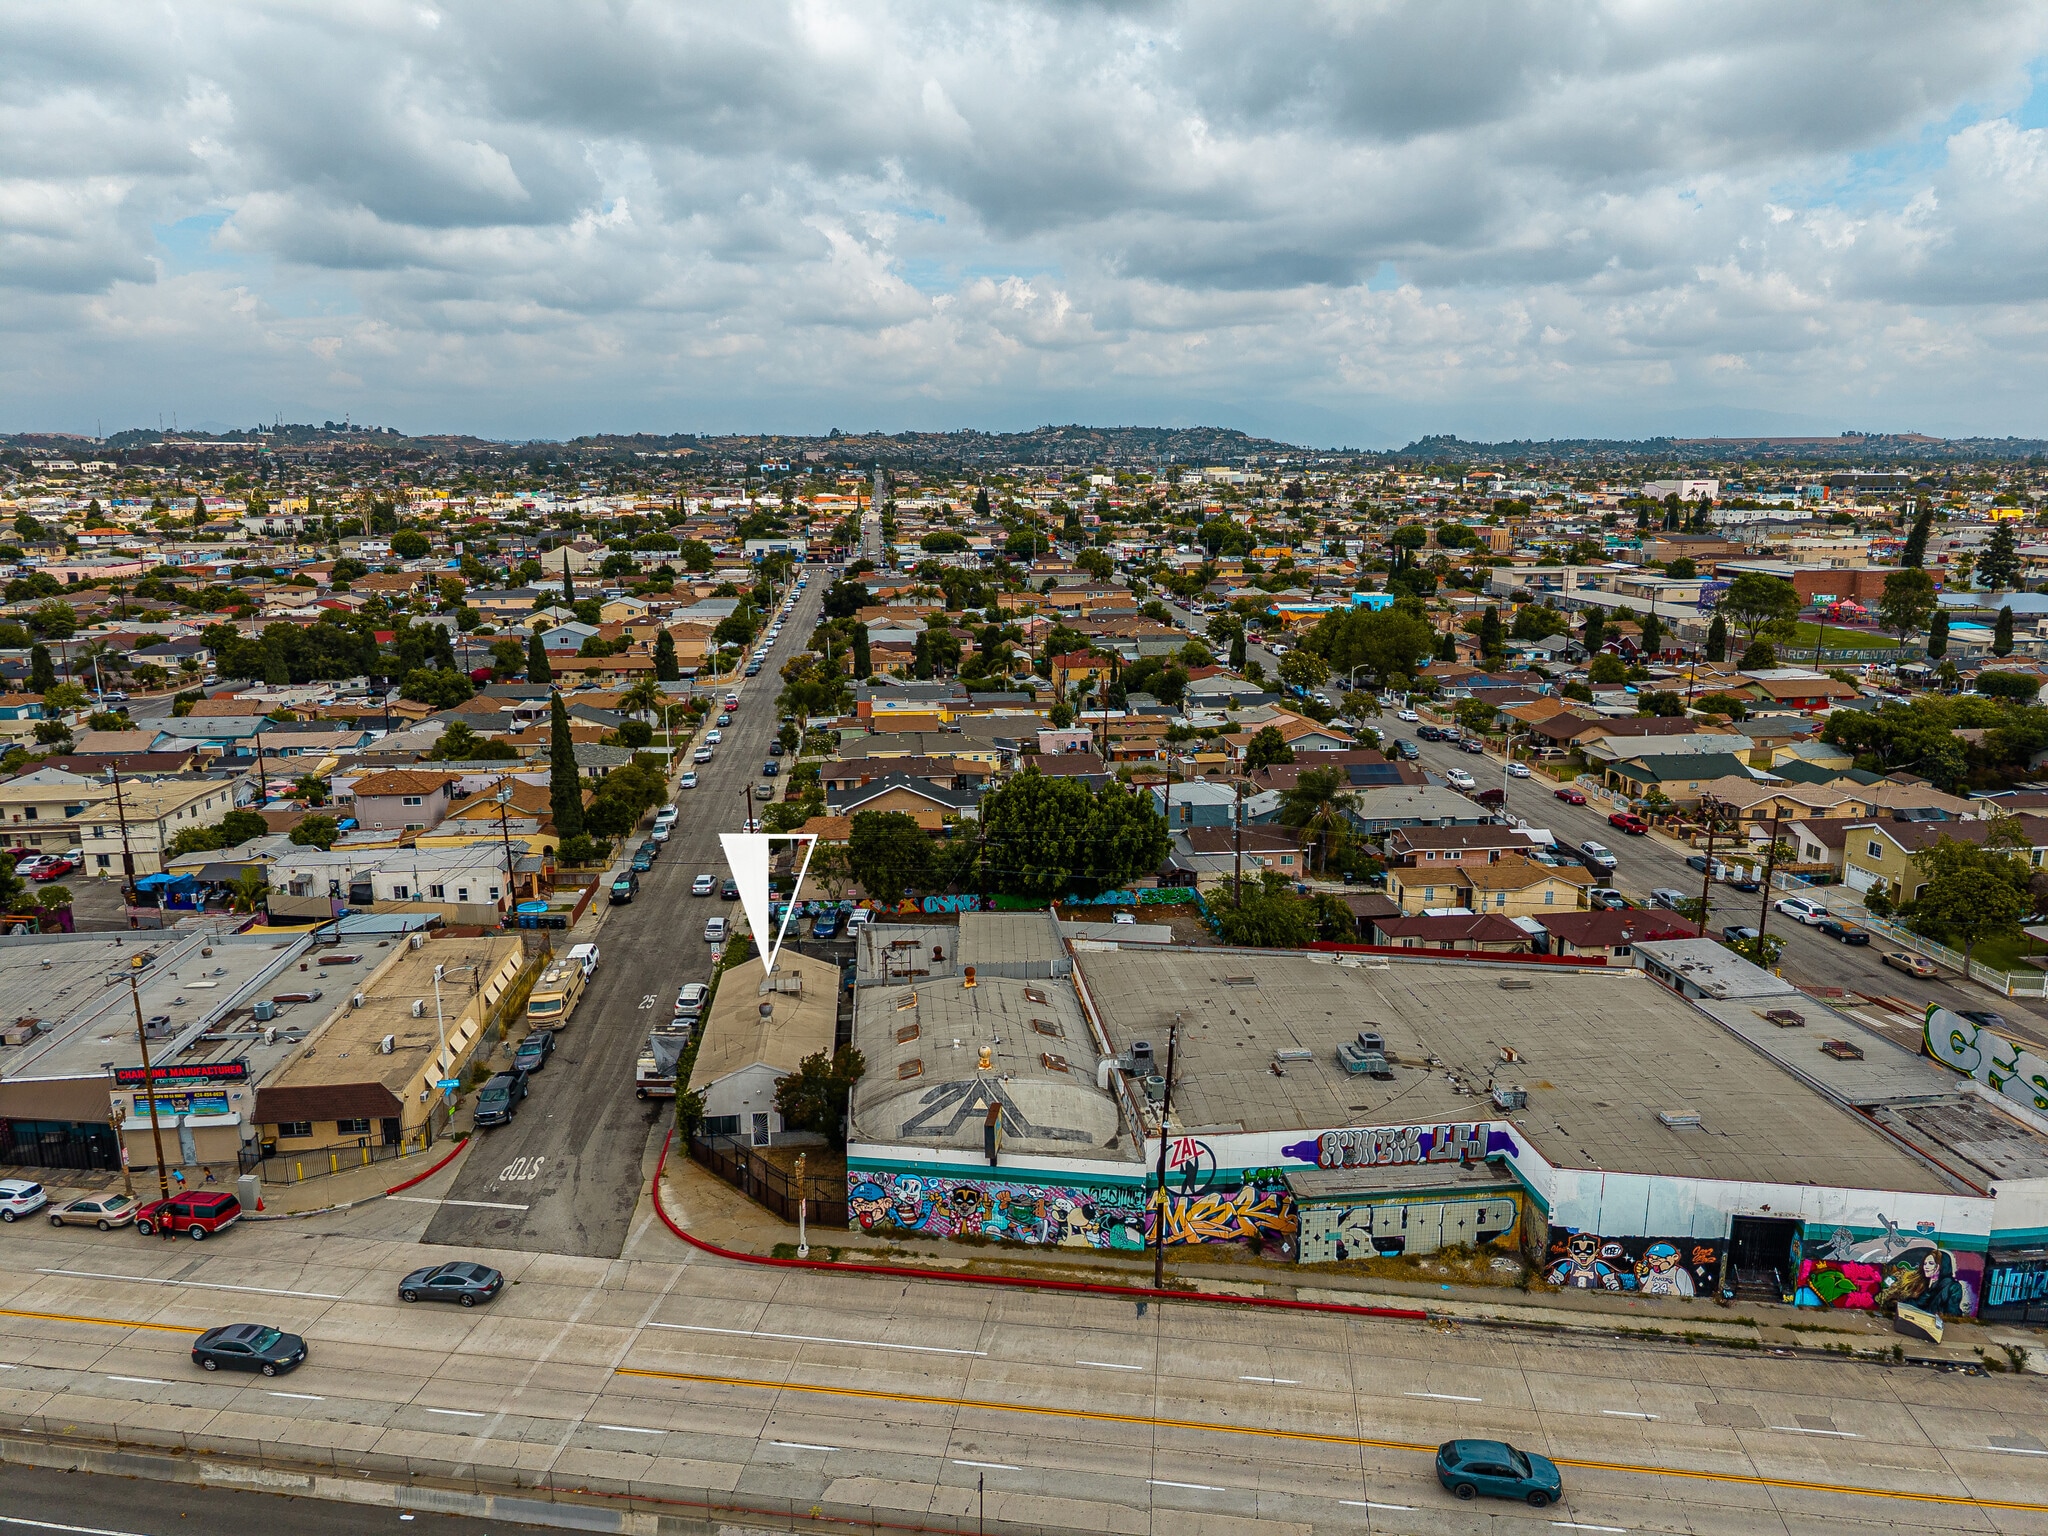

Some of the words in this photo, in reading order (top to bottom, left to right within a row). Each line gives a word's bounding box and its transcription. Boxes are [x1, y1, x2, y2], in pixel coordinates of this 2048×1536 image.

[1834, 649, 1907, 660] ELEMENTARY
[638, 995, 657, 1009] 25
[150, 1069, 167, 1078] INK
[170, 1065, 242, 1077] MANUFACTURER
[1170, 1137, 1205, 1168] ZAL
[499, 1156, 545, 1181] STOP
[1651, 1282, 1668, 1293] 24
